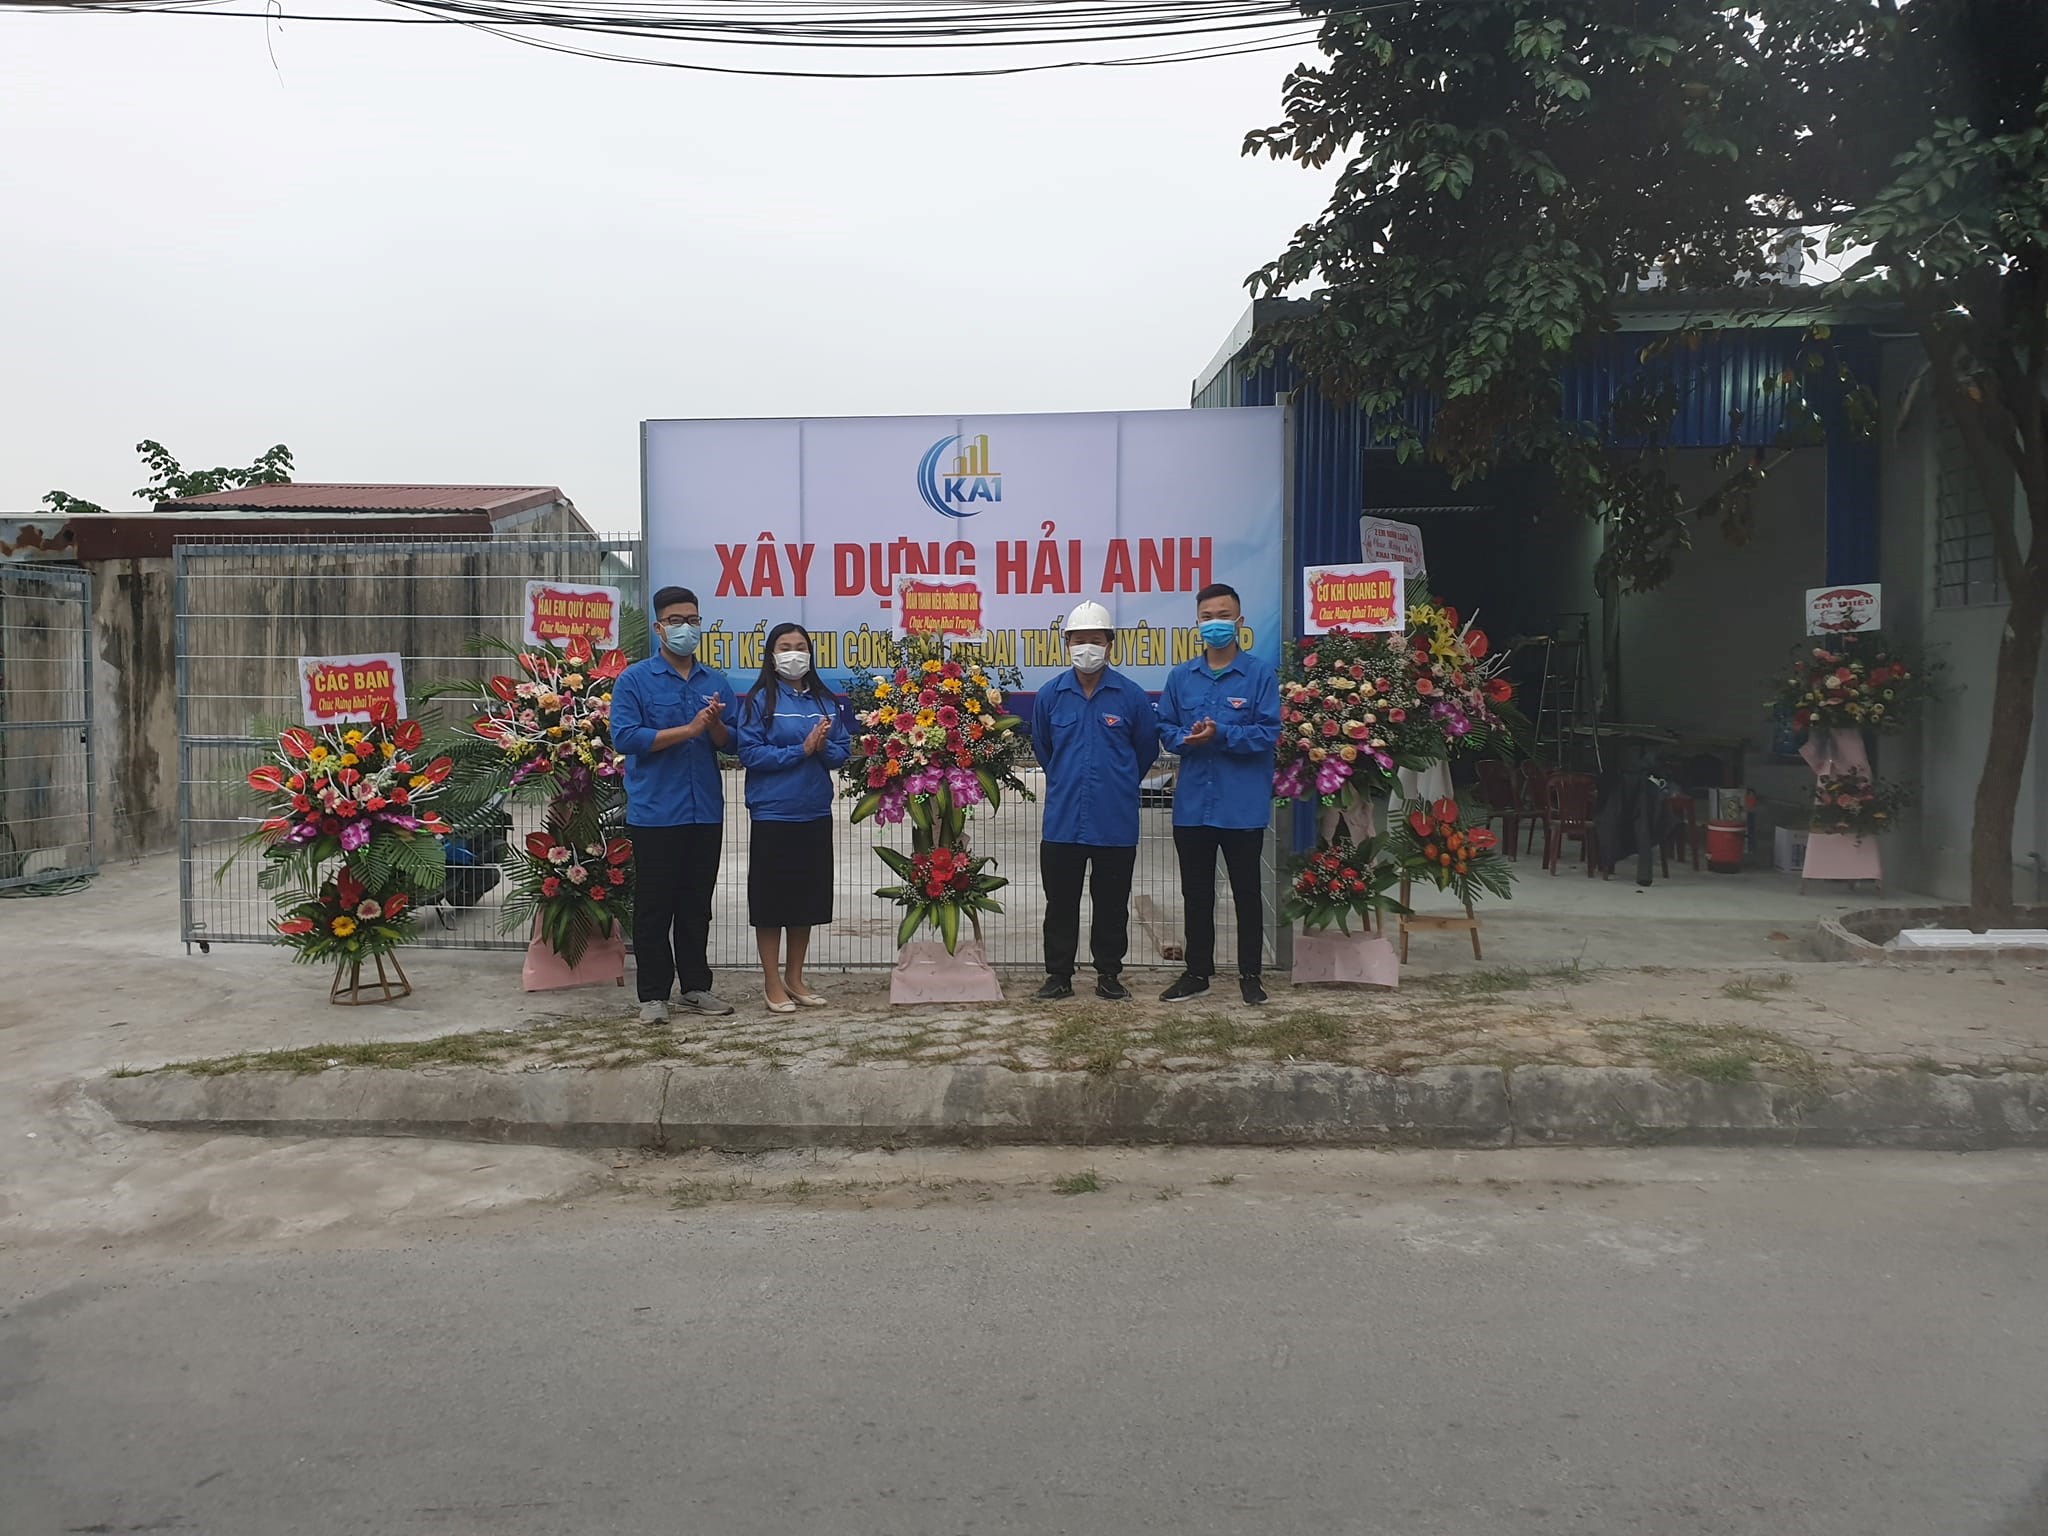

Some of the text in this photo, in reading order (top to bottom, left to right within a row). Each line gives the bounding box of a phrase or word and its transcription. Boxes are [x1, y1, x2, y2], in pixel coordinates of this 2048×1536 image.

[714, 520, 1213, 609] XÂY DỰNG HẢI ANH
[1317, 581, 1391, 602] CƠ KHÍ QUANG DU
[539, 599, 552, 616] HAI
[554, 601, 567, 617] EM
[315, 671, 390, 693] CÁC BẠN
